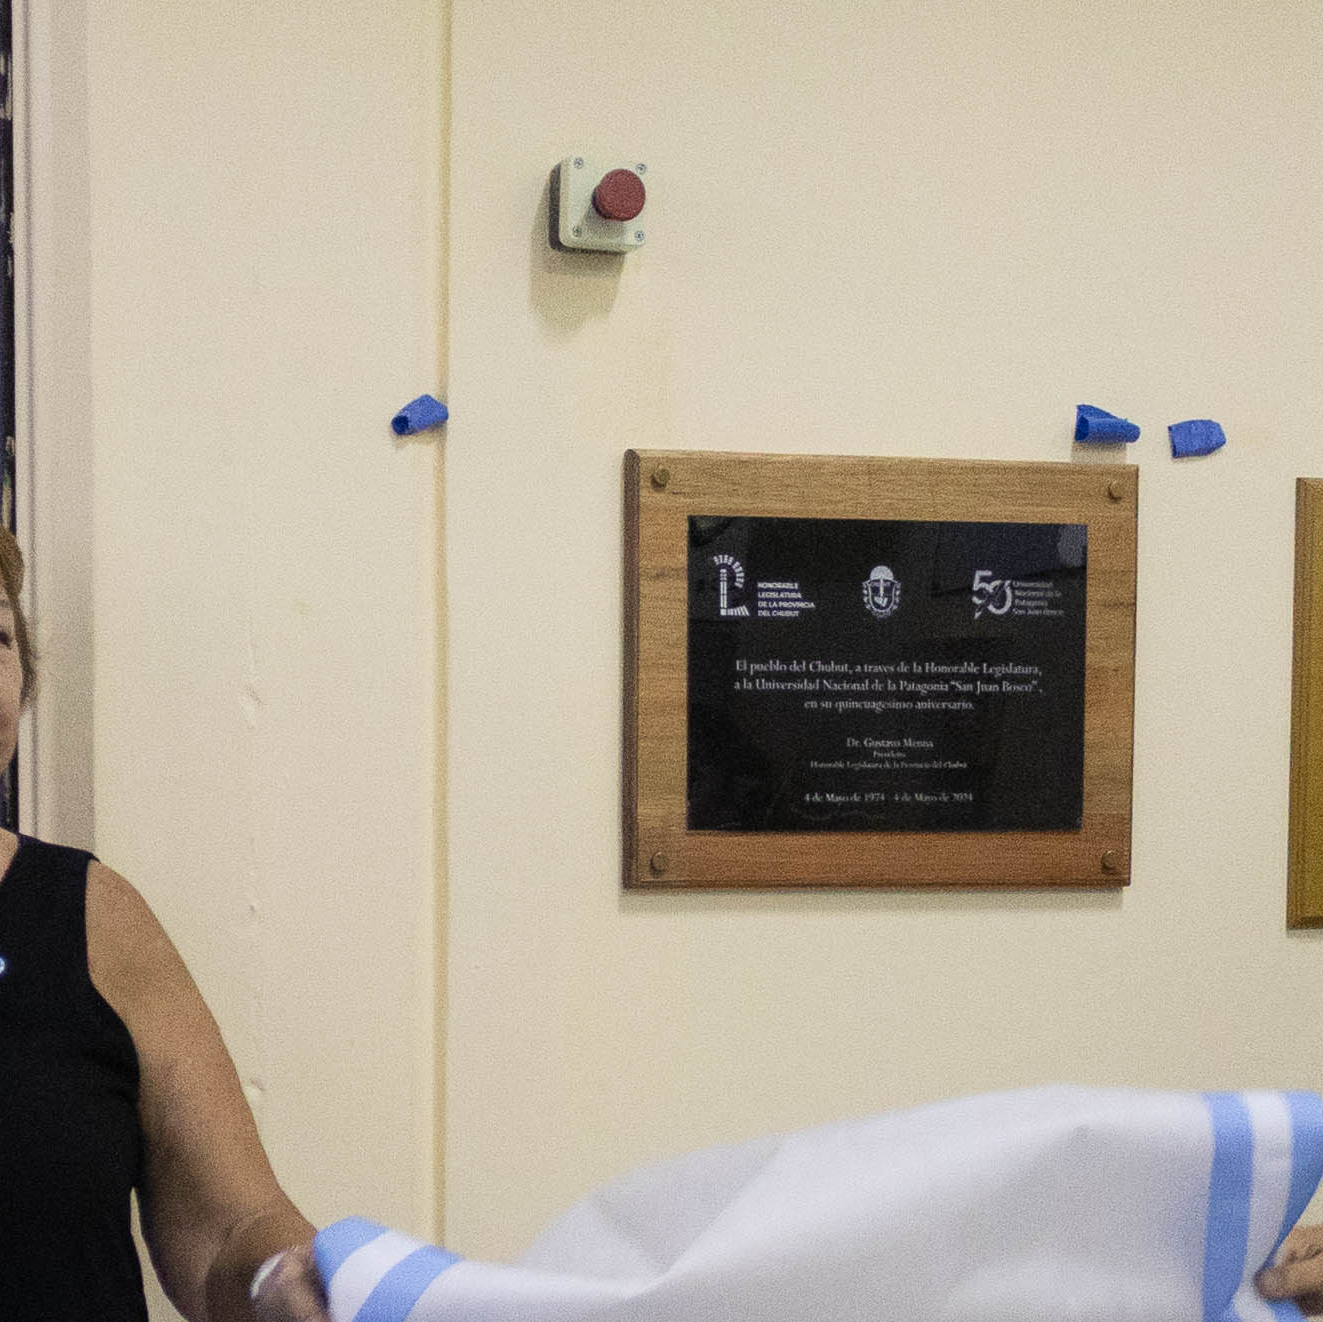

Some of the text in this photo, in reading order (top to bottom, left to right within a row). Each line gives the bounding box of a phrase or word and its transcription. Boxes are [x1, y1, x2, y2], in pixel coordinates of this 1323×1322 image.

[778, 601, 815, 609] PROVINCIA
[735, 660, 748, 671] El
[750, 660, 787, 675] pueblo
[789, 660, 806, 672] del
[809, 660, 853, 674] Chubut,
[855, 664, 862, 672] a
[896, 661, 910, 673] de
[913, 661, 923, 673] la
[925, 661, 980, 673] Honorable
[982, 662, 1043, 677] Legislatura,
[734, 682, 741, 690] a
[743, 678, 752, 690] la
[755, 678, 819, 690] Universidad
[823, 679, 869, 691] Nacional
[871, 679, 884, 691] de
[887, 680, 897, 691] la
[899, 680, 949, 696] Patagonia
[976, 681, 999, 694] Juan
[804, 700, 818, 709] en
[820, 701, 833, 709] su
[863, 737, 901, 748] Gustavo
[864, 792, 886, 802] 1974
